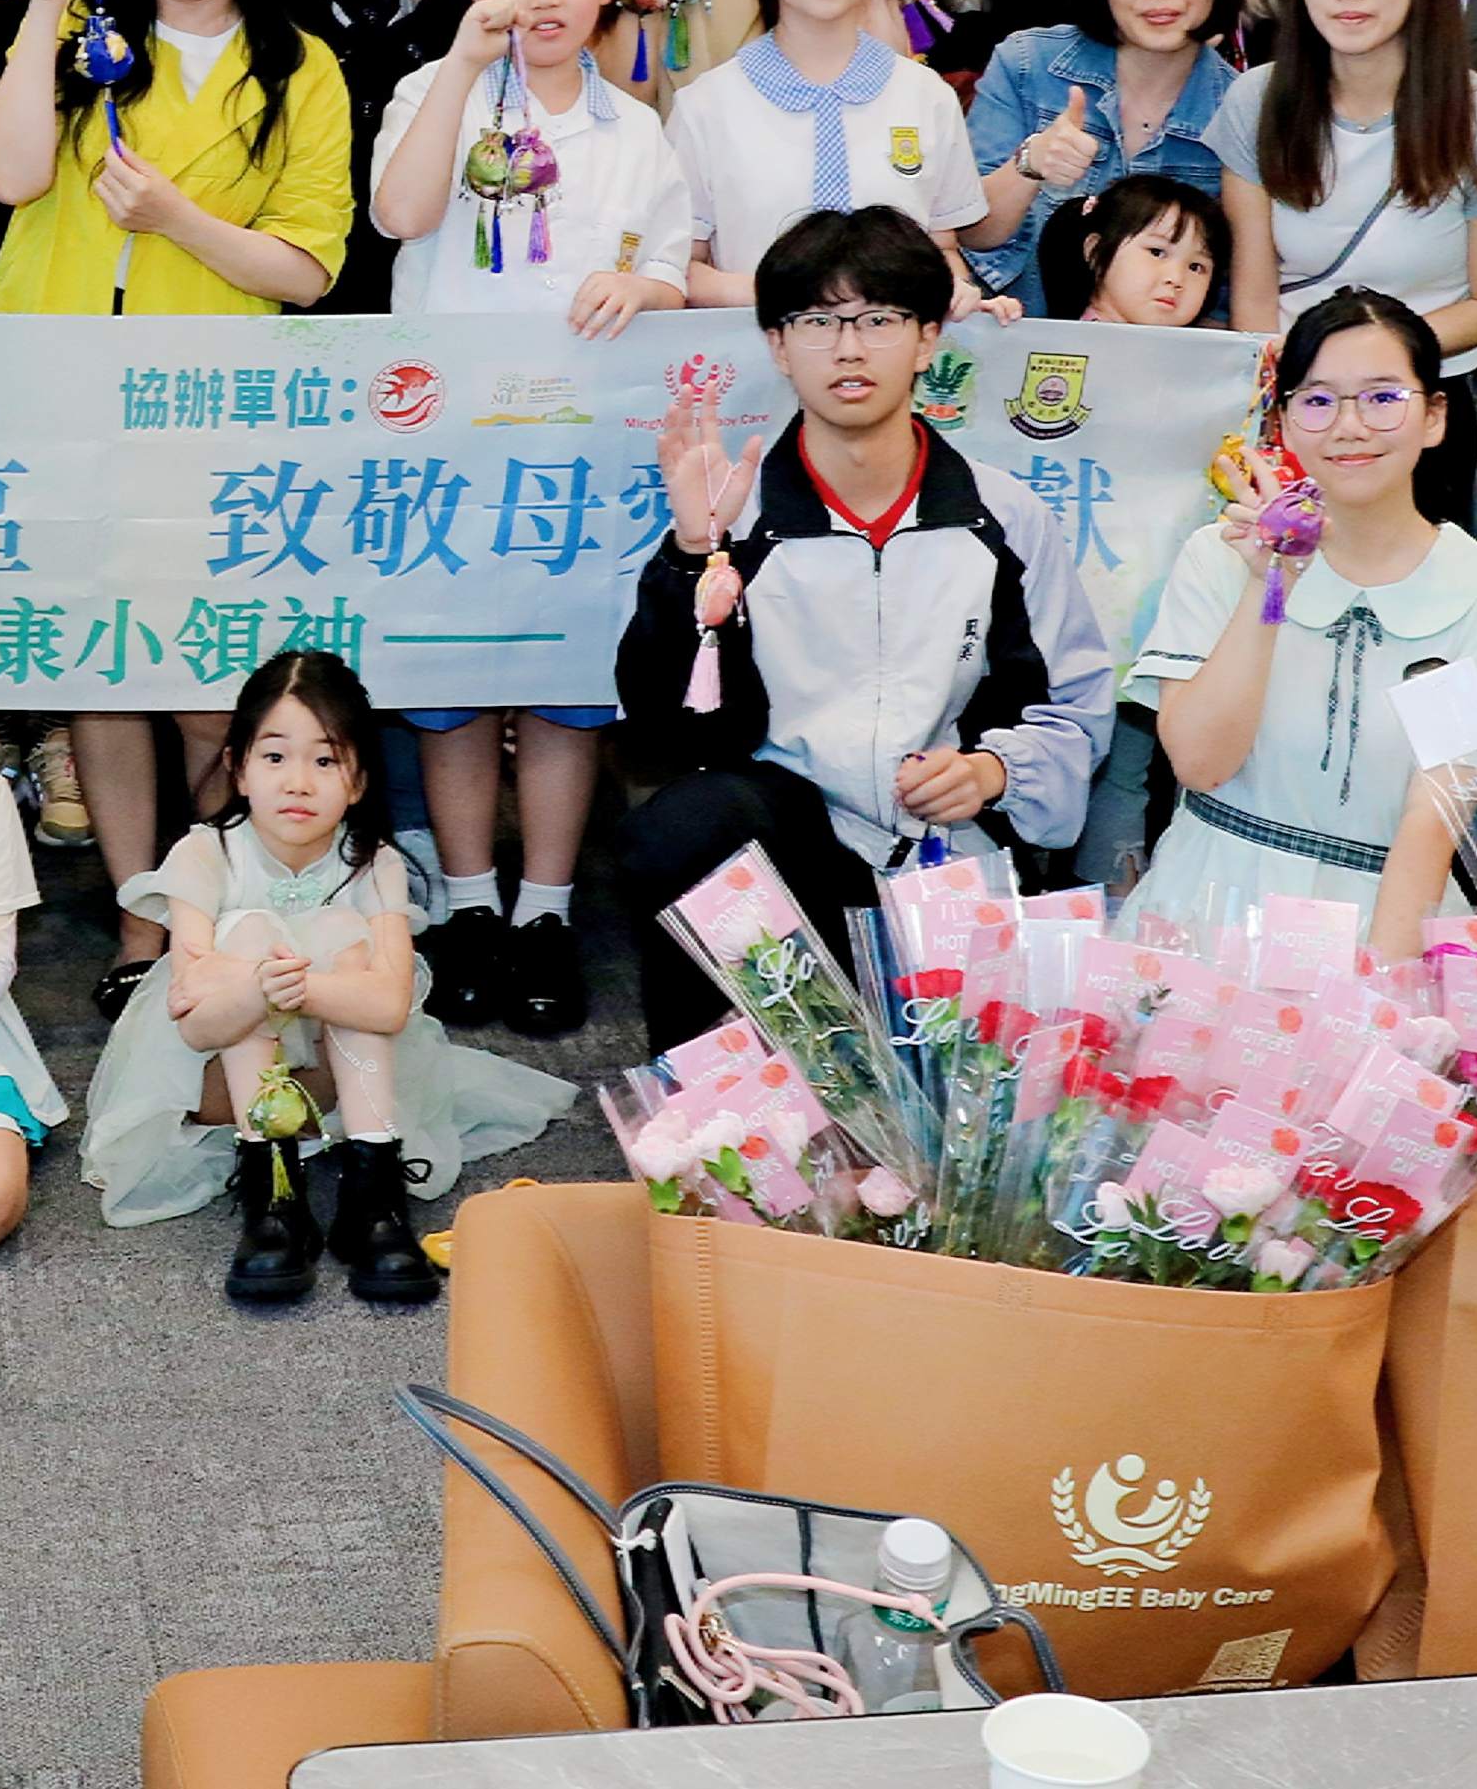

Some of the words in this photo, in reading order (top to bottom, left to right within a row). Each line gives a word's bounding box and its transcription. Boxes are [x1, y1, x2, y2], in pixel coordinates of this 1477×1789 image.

[995, 1580, 1136, 1612] ngMingEE
[1139, 1586, 1208, 1610] Baby
[1212, 1586, 1276, 1607] Care
